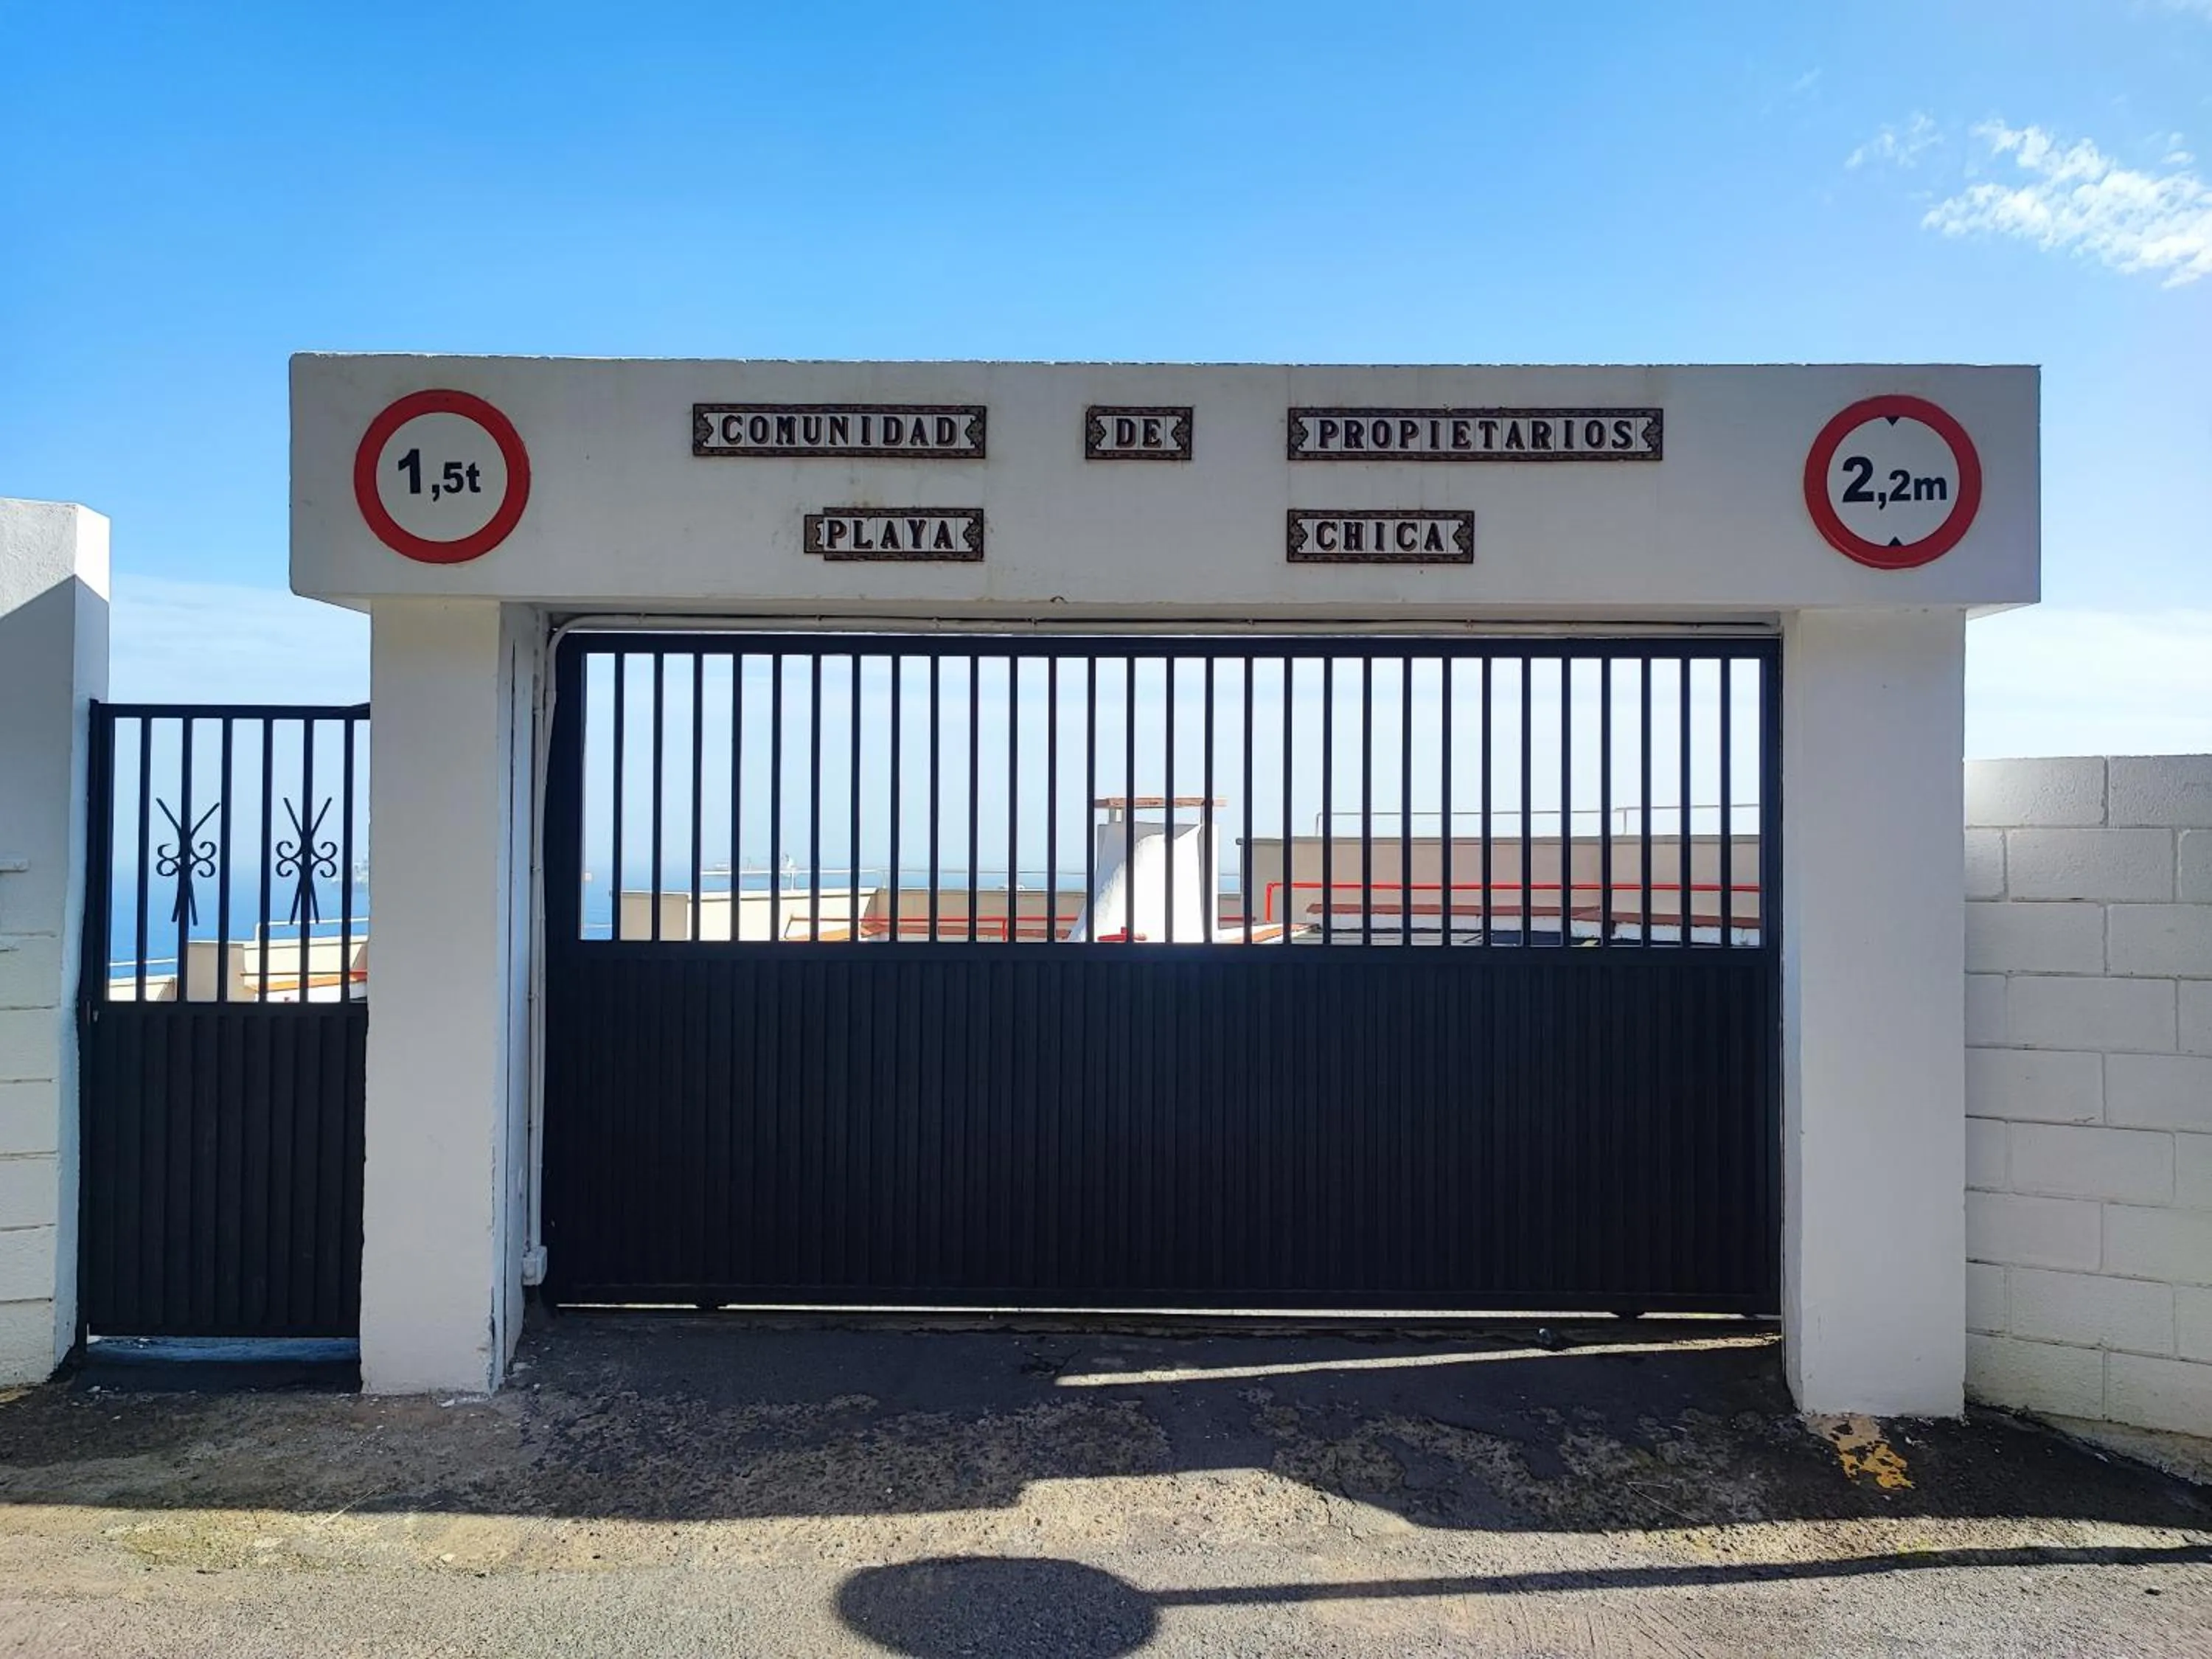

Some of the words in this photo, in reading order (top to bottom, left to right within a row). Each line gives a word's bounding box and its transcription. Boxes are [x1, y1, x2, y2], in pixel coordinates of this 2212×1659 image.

[721, 415, 958, 445] COMUNIDAD
[1115, 417, 1163, 448] DE
[1318, 419, 1633, 449] PROPIETARIOS
[397, 448, 481, 502] 1,5t
[1841, 456, 1948, 510] 2,2m
[826, 520, 955, 549] PLAYA
[1315, 521, 1446, 552] CHICA
